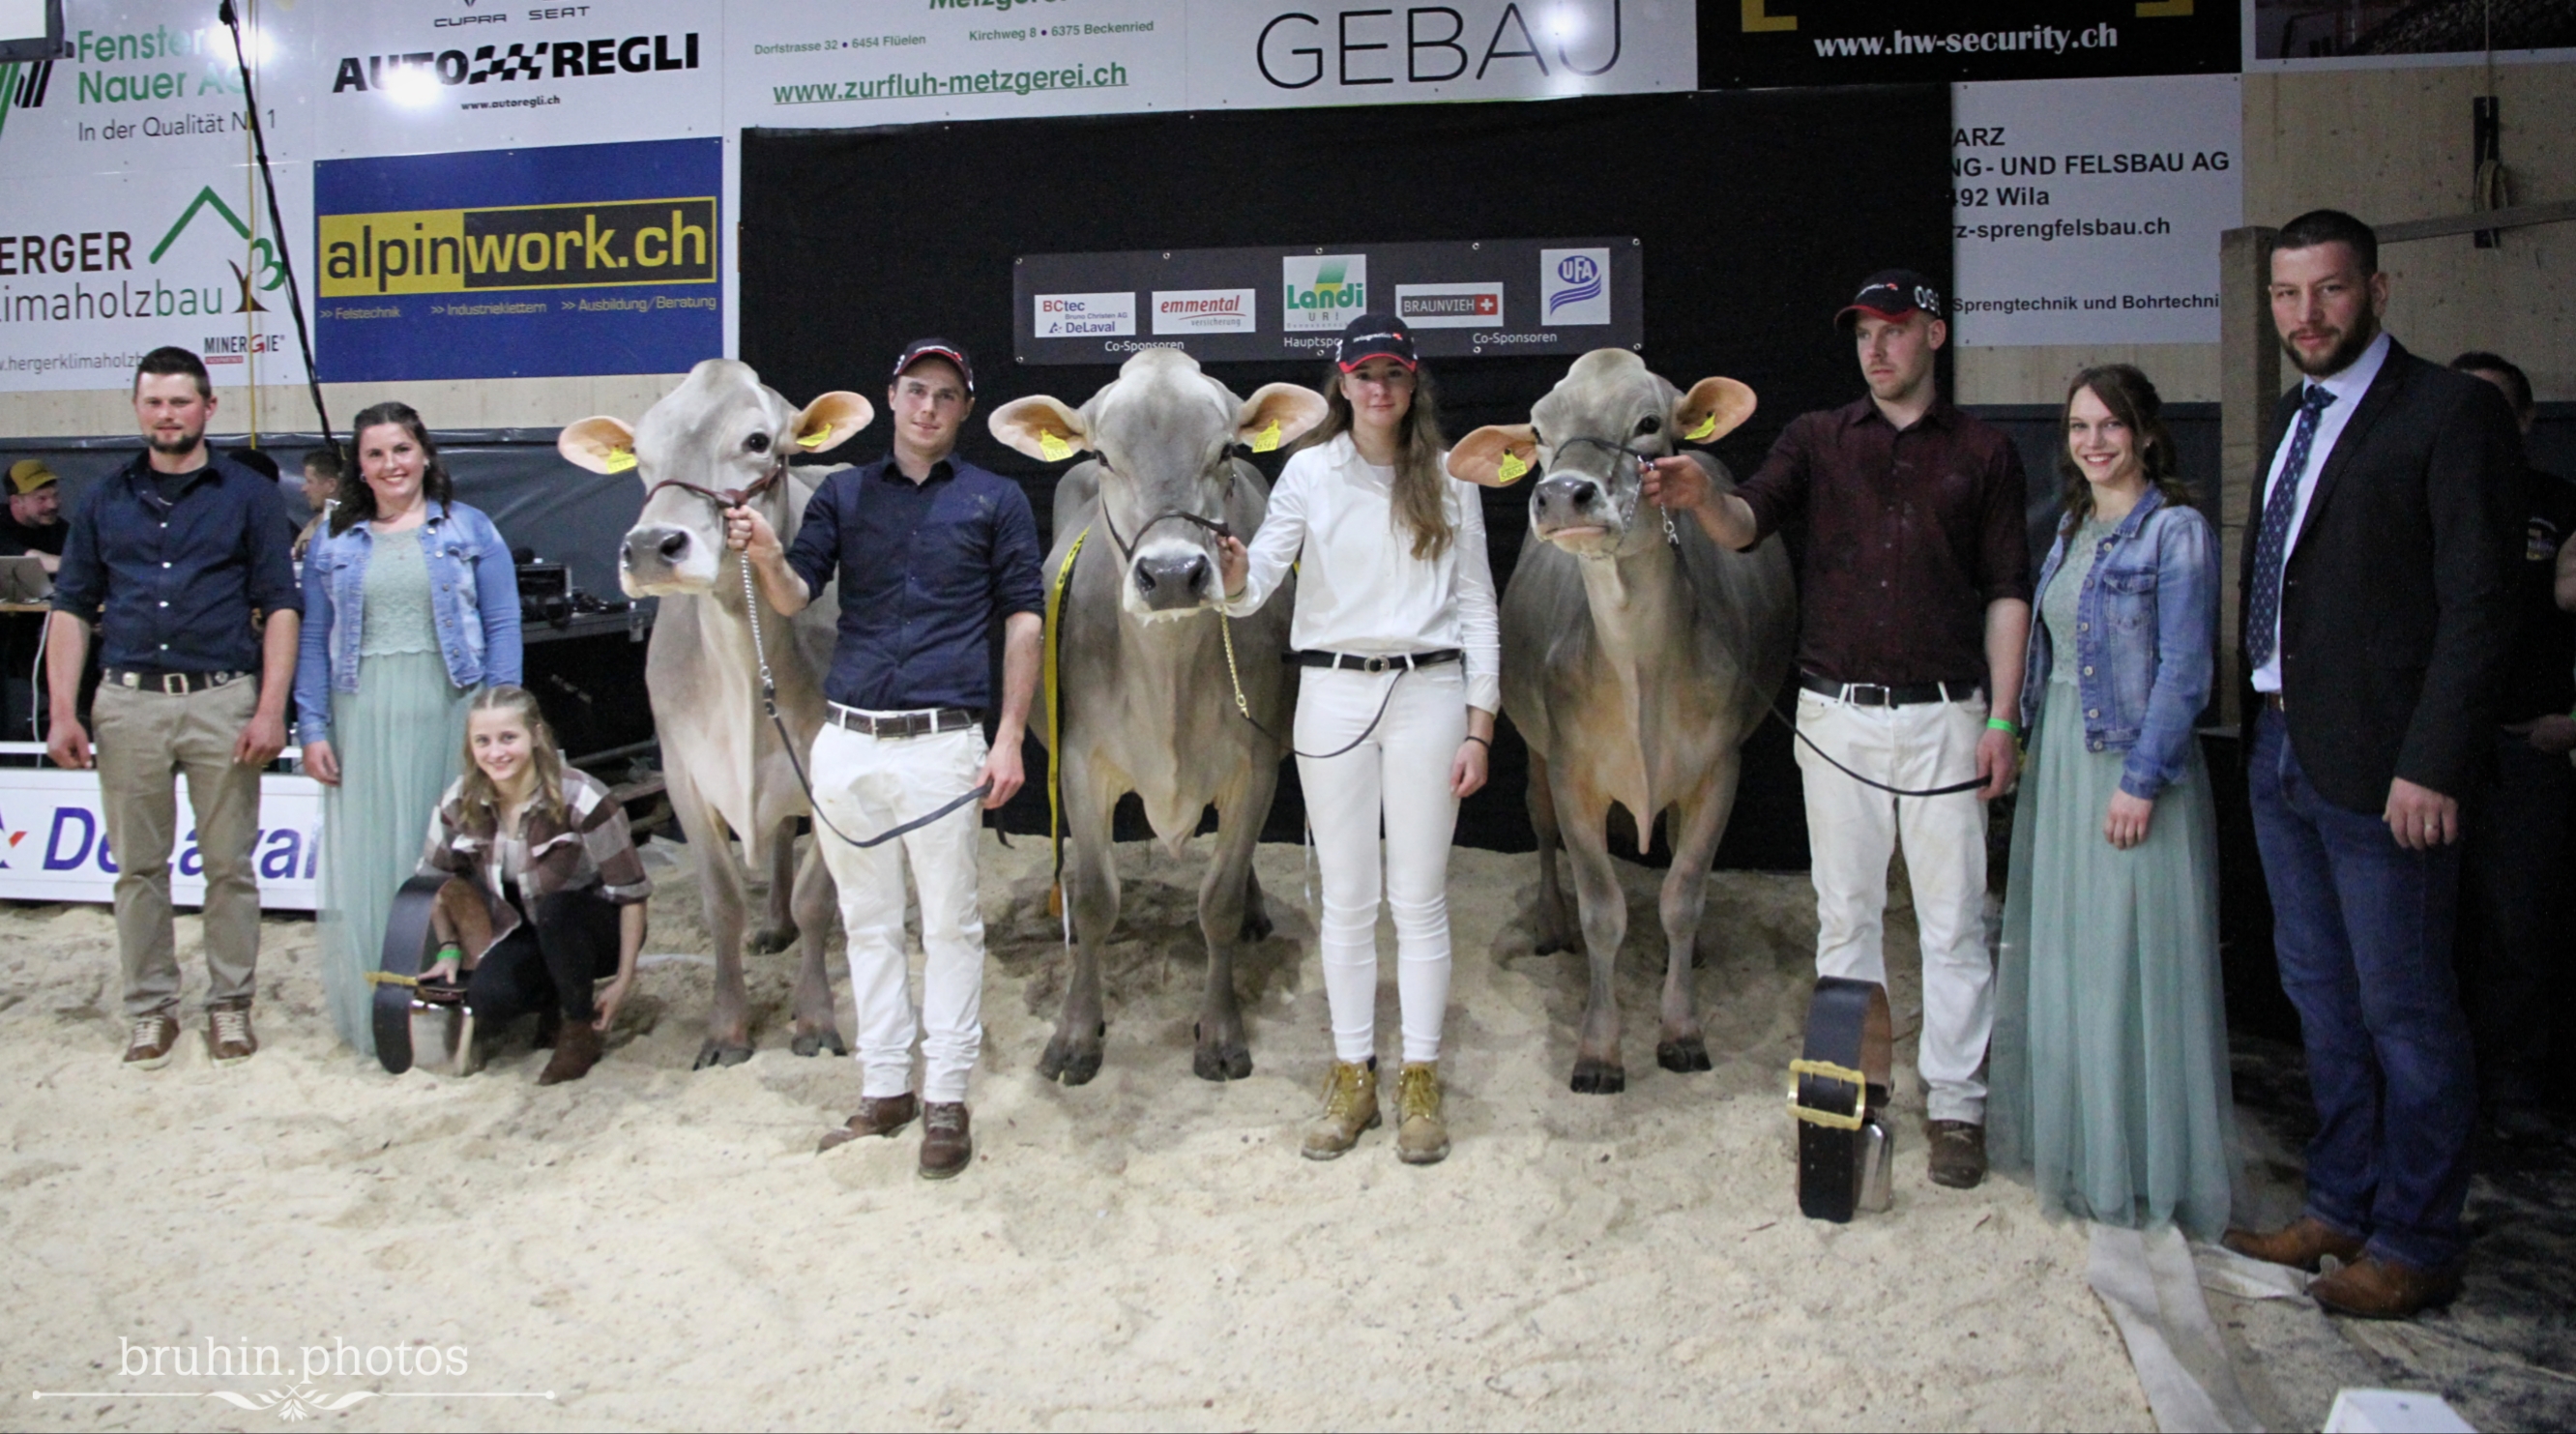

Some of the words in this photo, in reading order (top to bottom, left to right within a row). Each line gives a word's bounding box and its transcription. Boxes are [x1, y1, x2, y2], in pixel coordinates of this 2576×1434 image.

[434, 14, 507, 28] CUPRA
[529, 6, 590, 20] SEAT
[969, 29, 1026, 42] Kirchweg
[1029, 27, 1037, 38] 8
[1051, 25, 1080, 37] 6375
[1084, 20, 1155, 35] Beckenried
[1813, 22, 2118, 56] www.hw-security.ch
[78, 24, 205, 64] Fenster
[754, 42, 821, 55] Dorfstrasse
[824, 40, 838, 51] 32
[852, 37, 880, 49] 6454
[883, 35, 926, 46] Flüelen
[551, 33, 699, 77] REGLI
[78, 71, 187, 104] Nauer
[774, 62, 1127, 102] www.zurfluh-metzgerei.ch
[461, 95, 561, 111] www.autoregli.ch
[79, 122, 95, 141] In
[102, 119, 135, 140] der
[142, 113, 224, 137] Qualität
[1952, 127, 2005, 147] ARZ
[2001, 156, 2056, 176] UND
[2064, 153, 2184, 174] FELSBAU
[2191, 151, 2230, 171] AG
[1996, 187, 2050, 206] Wila
[0, 231, 133, 276] ERGER
[327, 210, 707, 292] alpinwork.ch
[1562, 258, 1594, 283] UFA
[1160, 294, 1241, 313] emmental
[1287, 282, 1364, 309] Landi
[1403, 298, 1476, 313] BRAUNVIEH
[1952, 295, 2079, 314] Sprengtechnik
[2084, 295, 2117, 310] und
[335, 306, 400, 320] Felstechnik
[447, 302, 547, 316] Industrieklettern
[1042, 300, 1085, 312] BCtec
[1066, 321, 1116, 334] DeLaval
[1190, 317, 1242, 328] versicherung
[204, 334, 279, 354] MINERGIE
[1104, 340, 1185, 353] Co-Sponsoren
[1472, 331, 1558, 345] Co-Sponsoren
